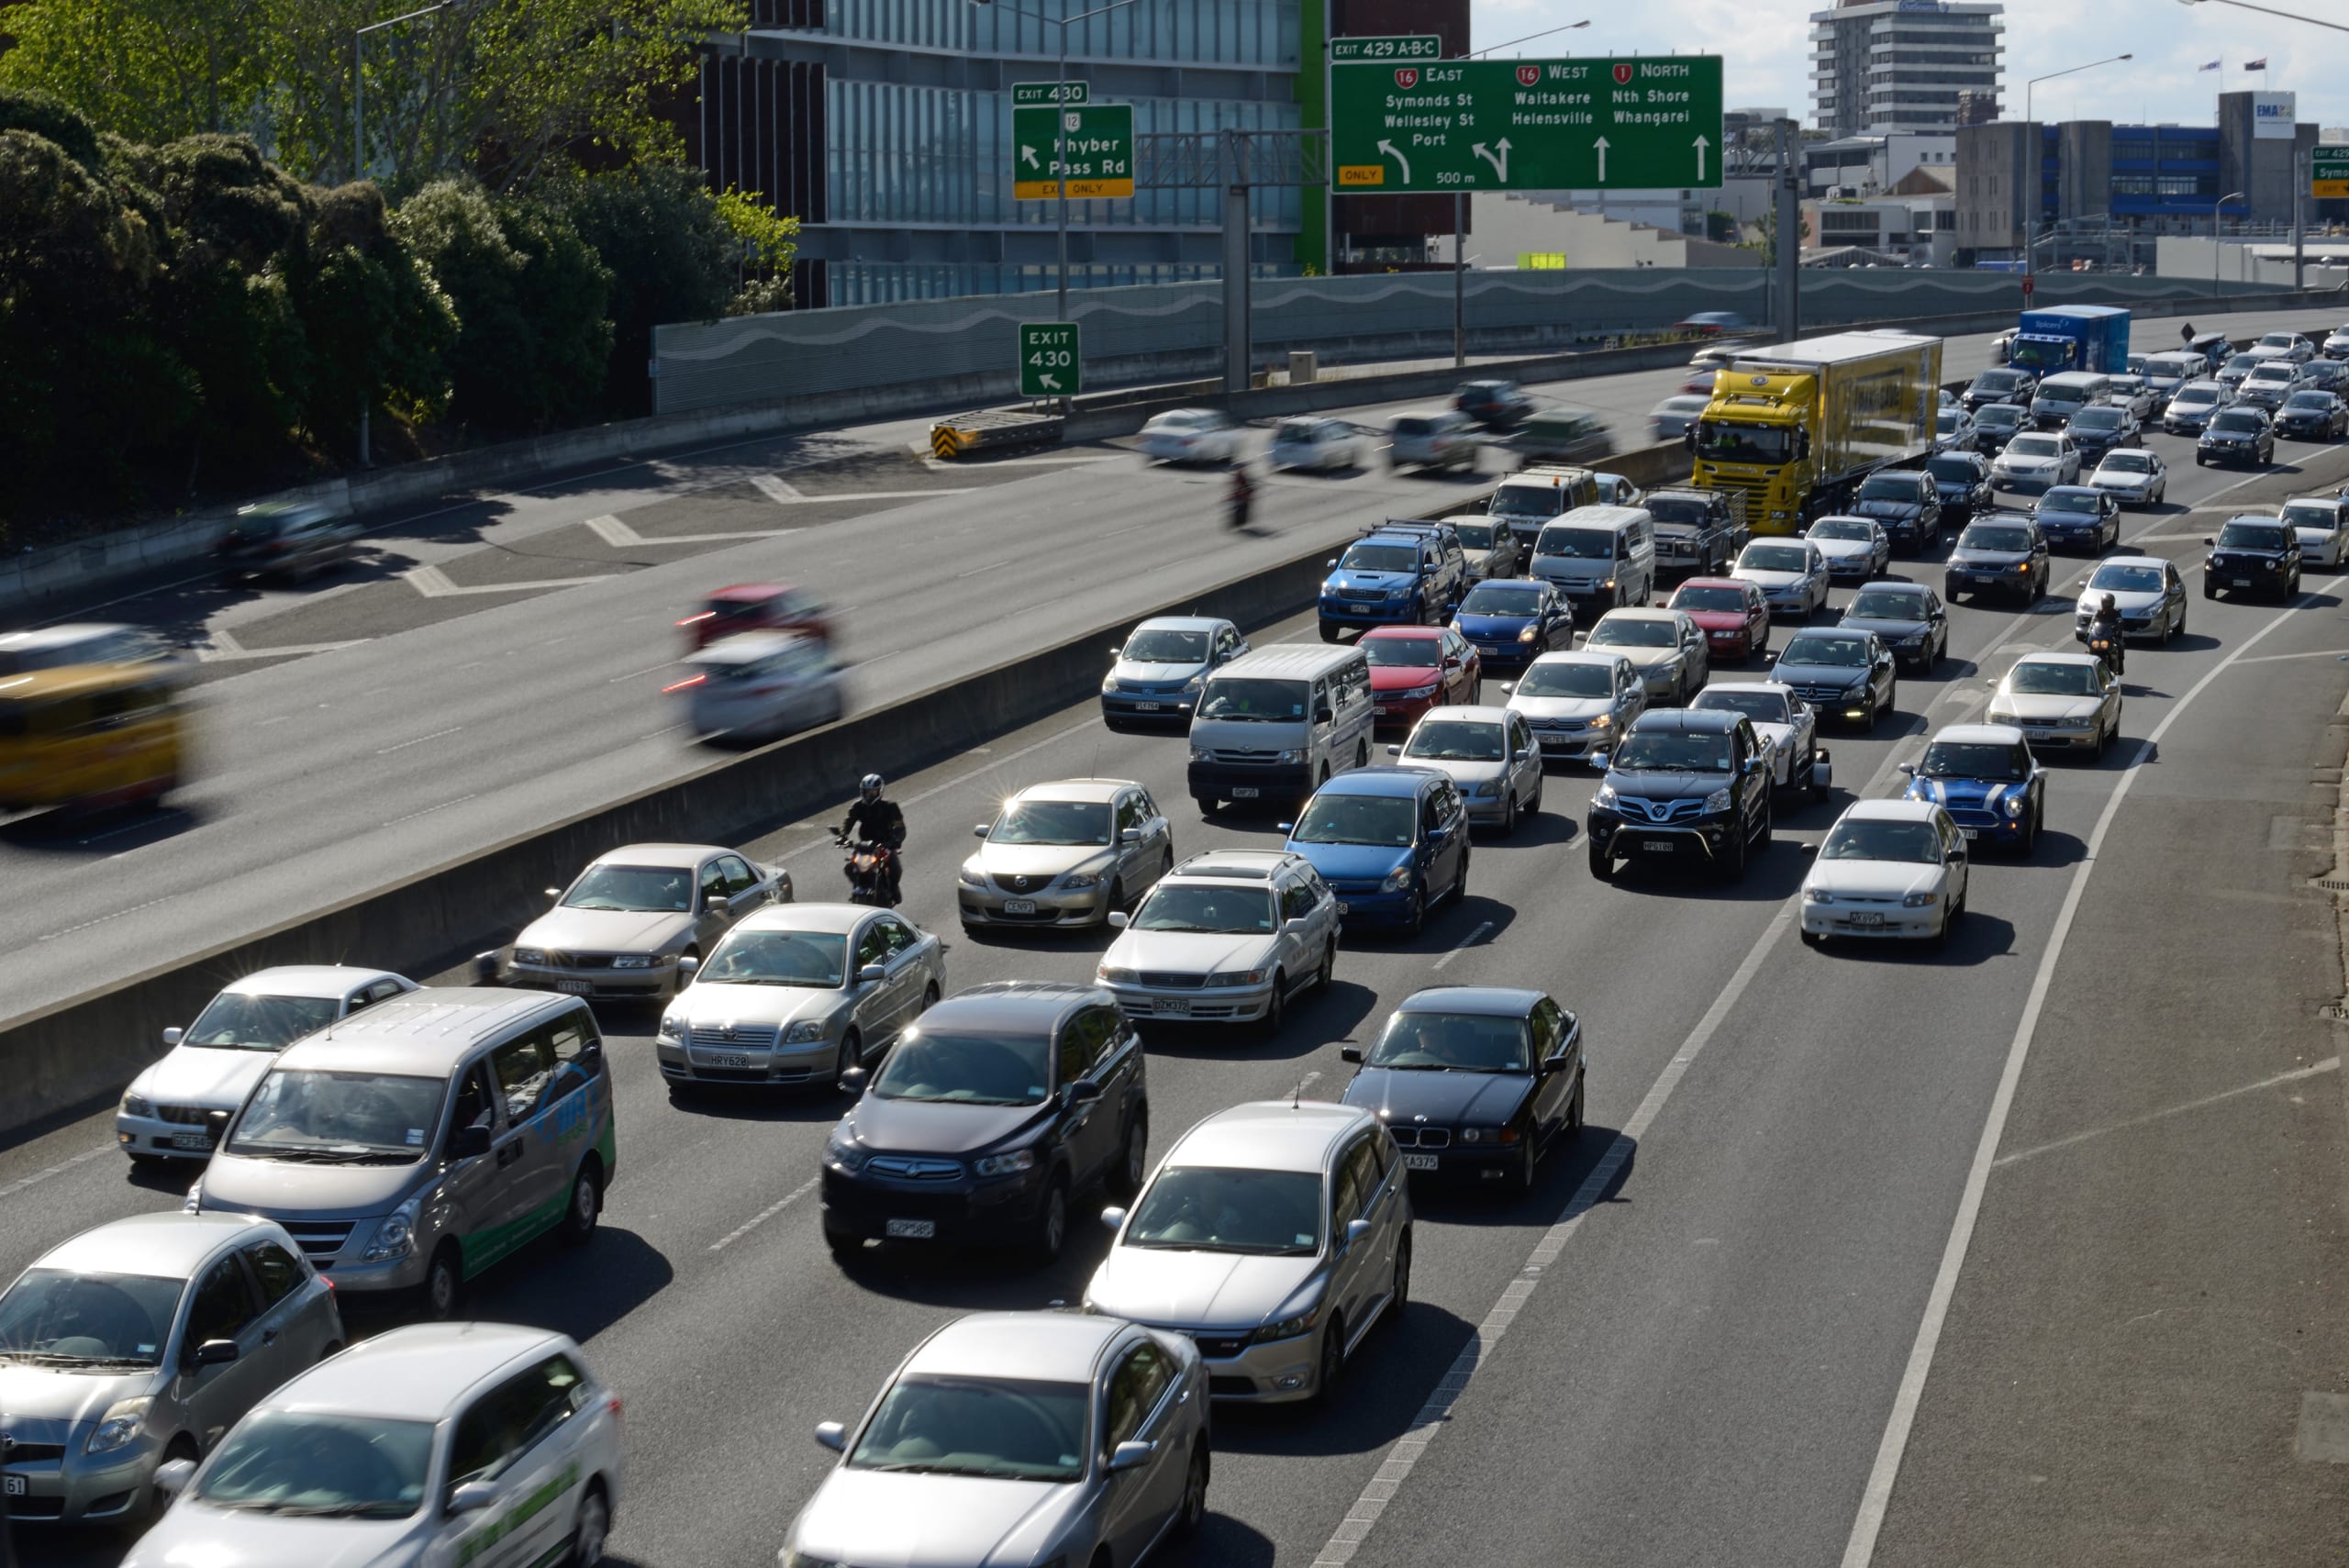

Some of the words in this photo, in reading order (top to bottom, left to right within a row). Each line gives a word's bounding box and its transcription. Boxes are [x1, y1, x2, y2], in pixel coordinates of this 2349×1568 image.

[1335, 44, 1358, 55] EXIT
[1363, 42, 1394, 57] 429
[1397, 40, 1434, 56] A-B-C
[1399, 72, 1413, 83] 16
[1426, 68, 1463, 82] EAST
[1521, 69, 1536, 82] 16
[1548, 65, 1588, 80] WEST
[1641, 63, 1688, 78] NORTH
[1018, 89, 1042, 100] EXIT
[1048, 86, 1083, 100] 430
[1515, 91, 1591, 106] Waitakere
[1612, 90, 1639, 104] Nth
[1647, 89, 1689, 103] Shore
[1386, 94, 1452, 110] Symonds
[1457, 94, 1473, 107] St
[1512, 111, 1593, 126] Helensville
[1613, 109, 1689, 127] Whangarei
[2256, 105, 2278, 117] EMA
[1067, 116, 1077, 128] 12
[1385, 113, 1451, 129] Wellesley
[1459, 113, 1475, 128] St
[1413, 132, 1446, 147] Port
[1049, 161, 1091, 175] Pass
[1102, 160, 1125, 173] Rd
[1344, 169, 1377, 182] ONLY
[1436, 172, 1461, 184] 500
[1464, 174, 1475, 183] m
[1073, 183, 1103, 194] ONLY
[1029, 331, 1069, 345] EXIT
[1028, 350, 1071, 367] 430
[1008, 902, 1032, 911] CEN93
